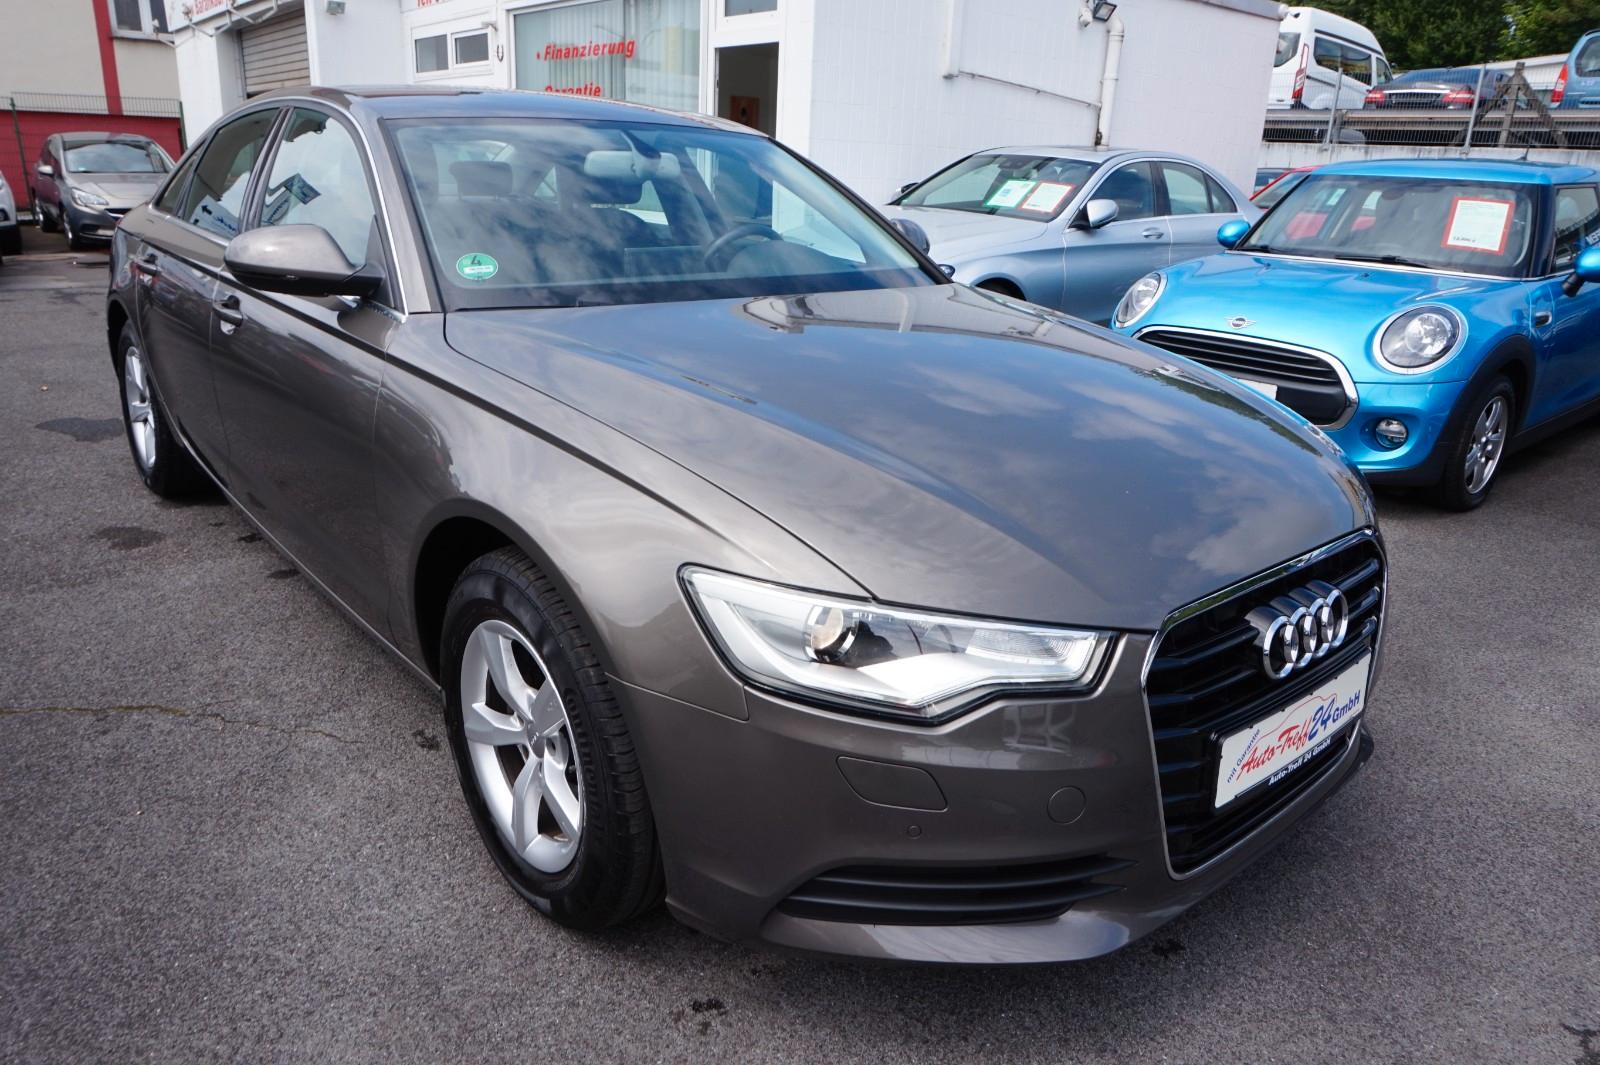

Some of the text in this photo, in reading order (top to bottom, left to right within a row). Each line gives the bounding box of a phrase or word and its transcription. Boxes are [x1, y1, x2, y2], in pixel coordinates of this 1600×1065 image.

[544, 40, 636, 60] Finanzierung
[1332, 690, 1360, 723] GmbH
[1227, 728, 1260, 783] mit Garantie
[1268, 736, 1331, 786] Auto-Treff 24 GmbH
